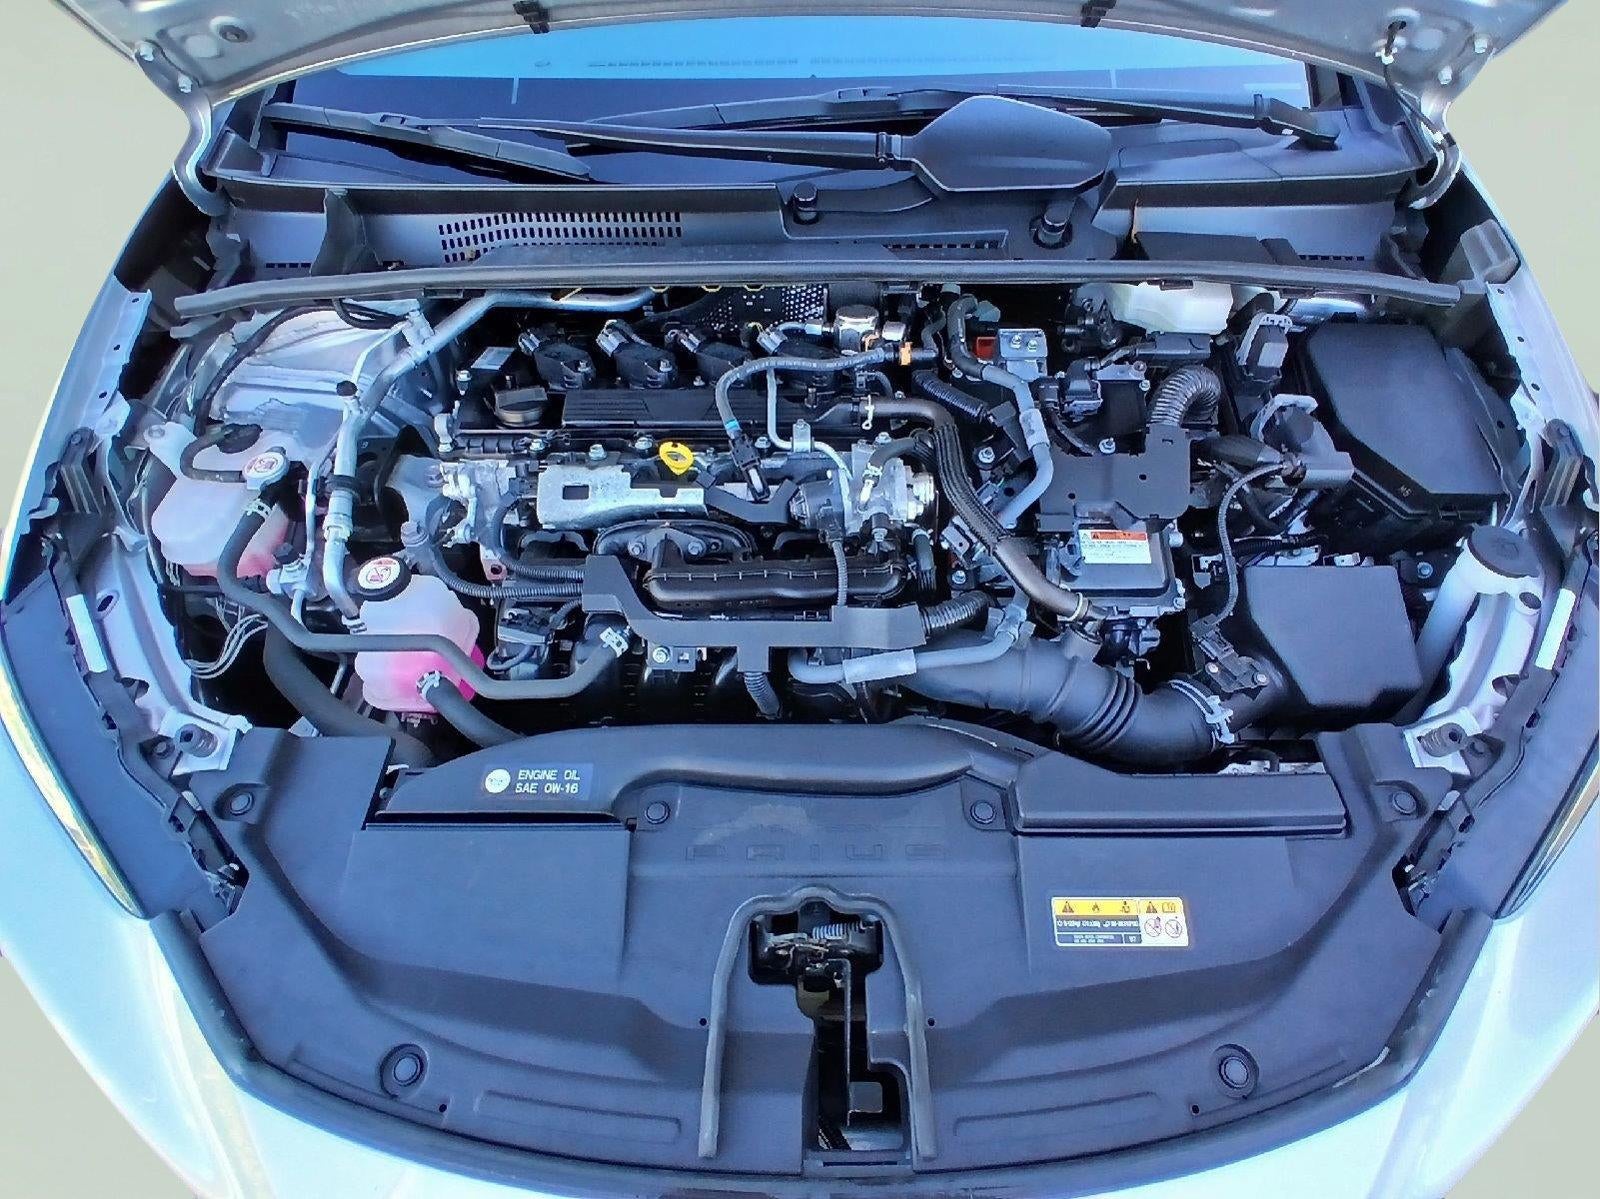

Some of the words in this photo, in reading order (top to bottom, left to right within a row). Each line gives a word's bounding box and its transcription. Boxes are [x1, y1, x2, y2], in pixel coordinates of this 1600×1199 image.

[518, 769, 558, 781] ENGINE
[564, 769, 580, 781] OIL
[515, 783, 538, 794] SAE
